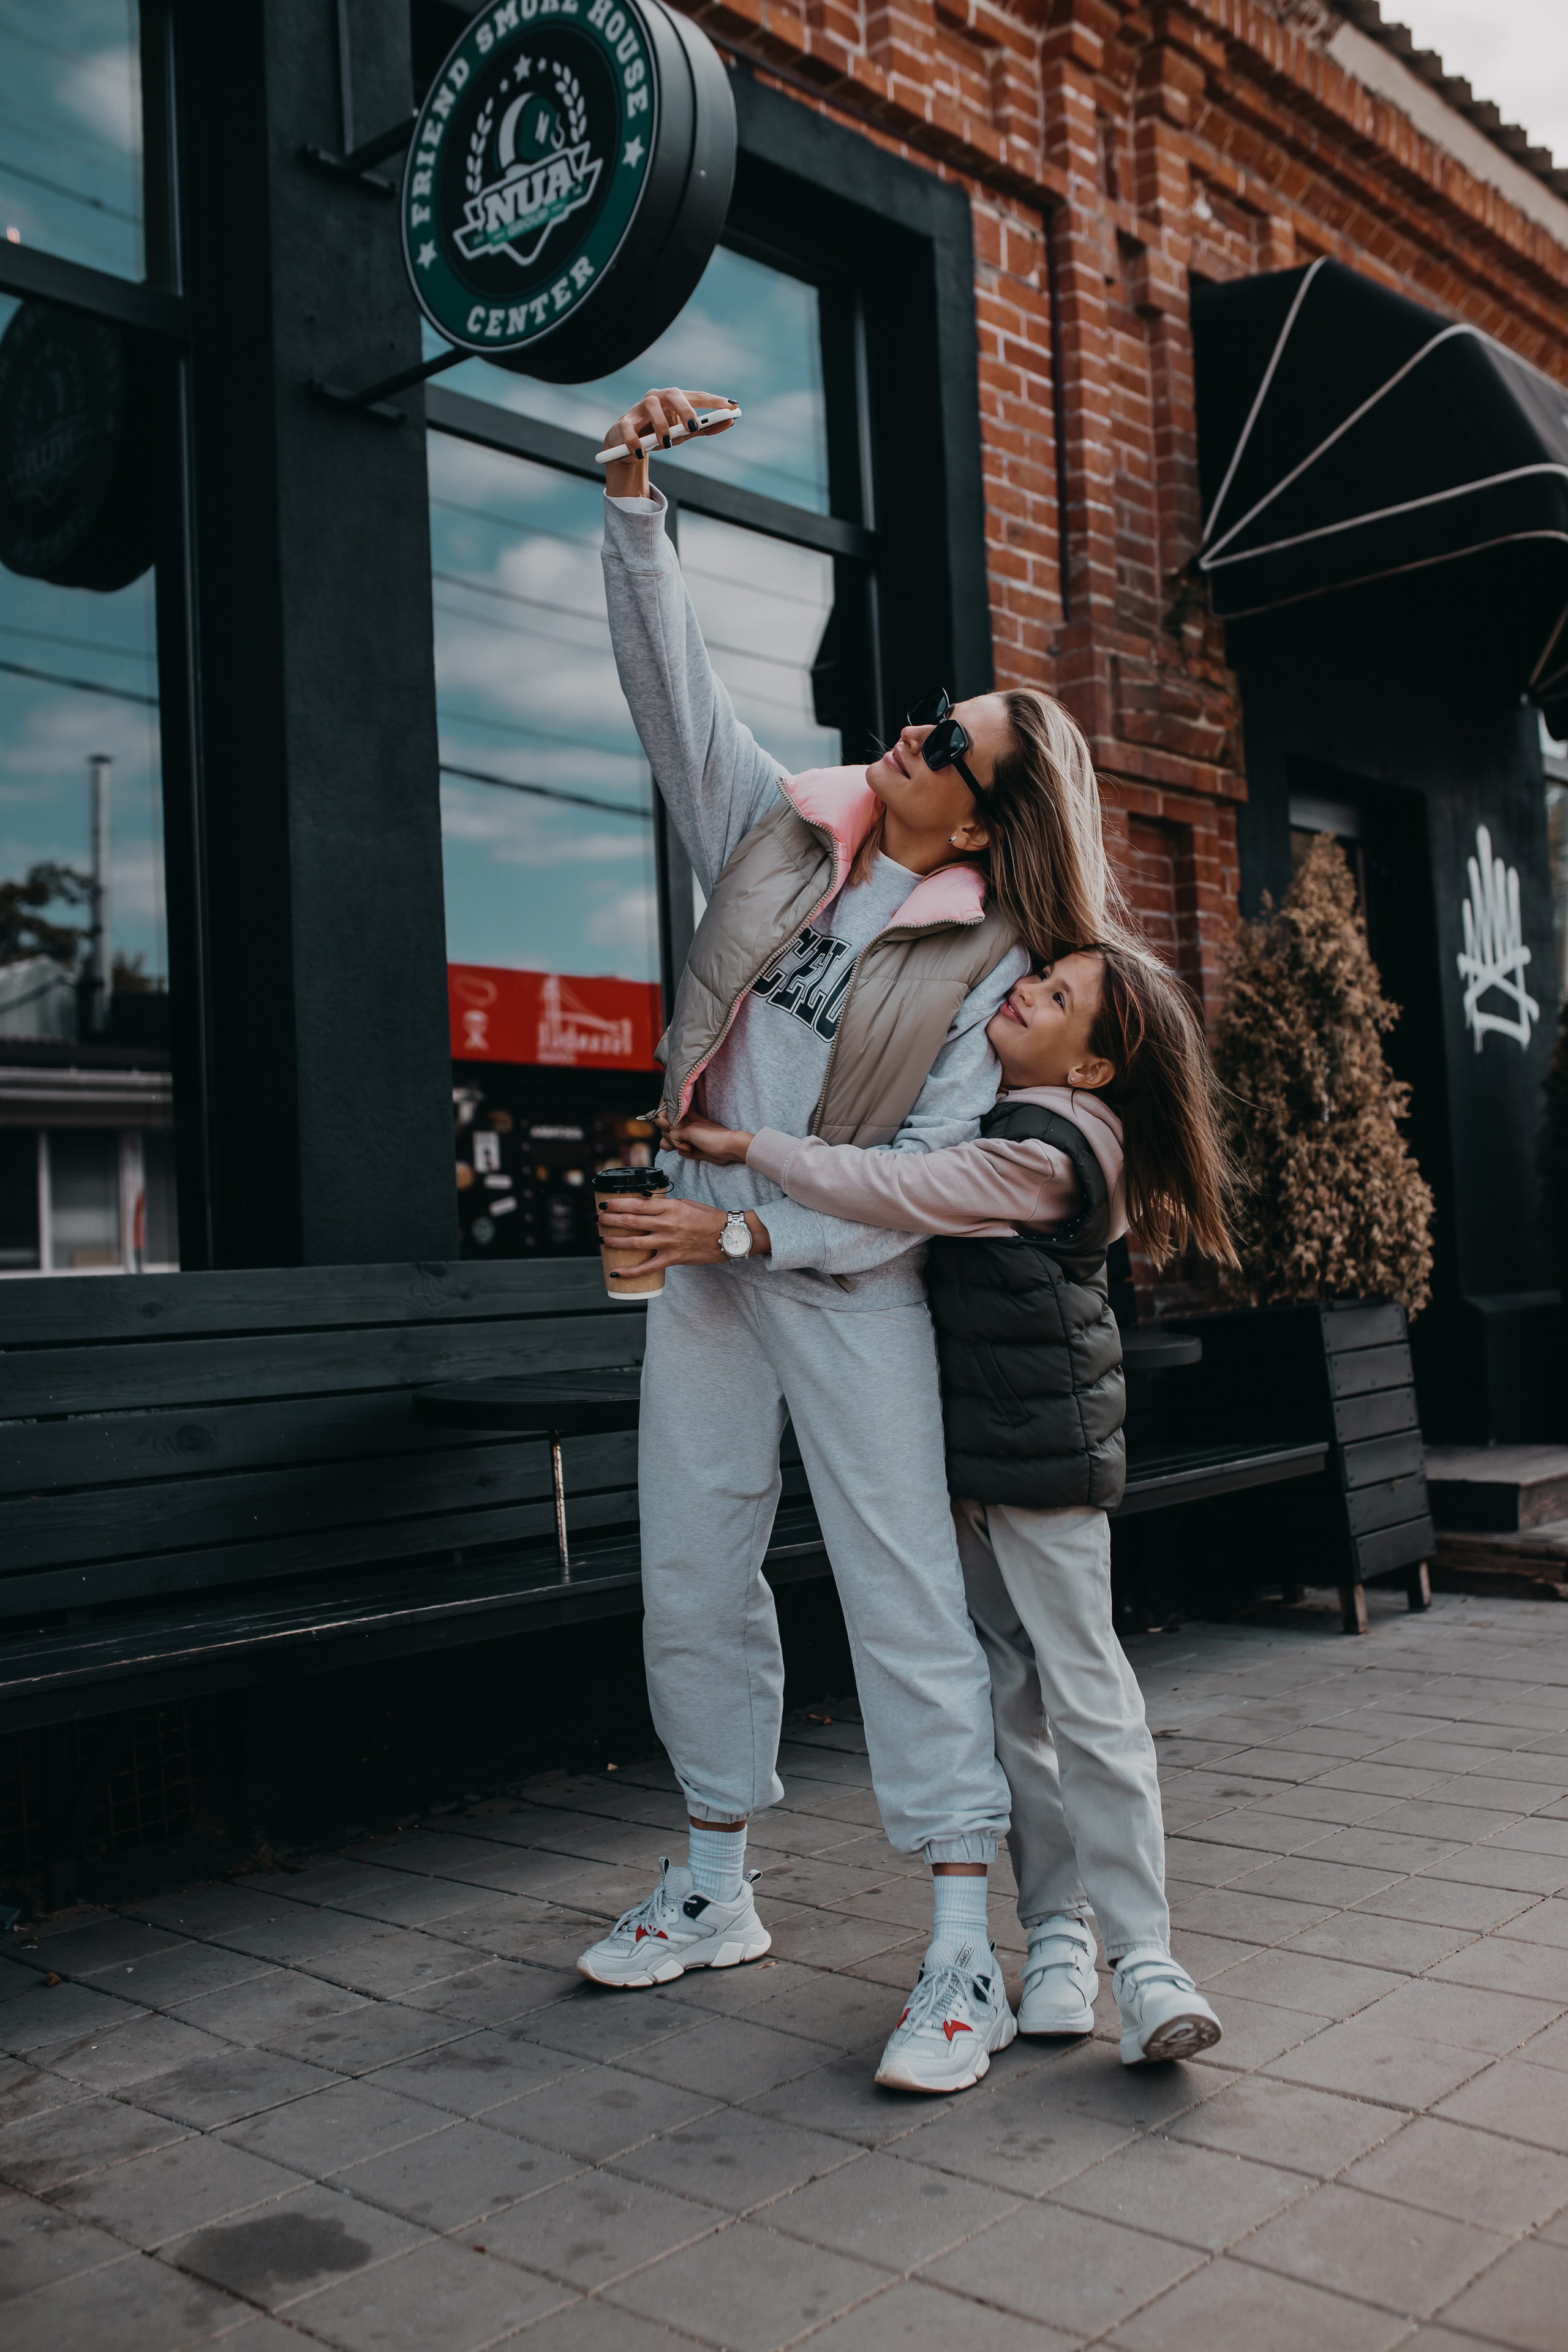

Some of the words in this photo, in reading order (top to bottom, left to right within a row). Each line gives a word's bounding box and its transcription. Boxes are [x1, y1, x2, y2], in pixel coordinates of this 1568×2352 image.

[412, 56, 470, 227] FRIEND
[587, 0, 649, 119] HOUSE
[483, 162, 575, 232] NUA
[466, 255, 594, 337] CENTER
